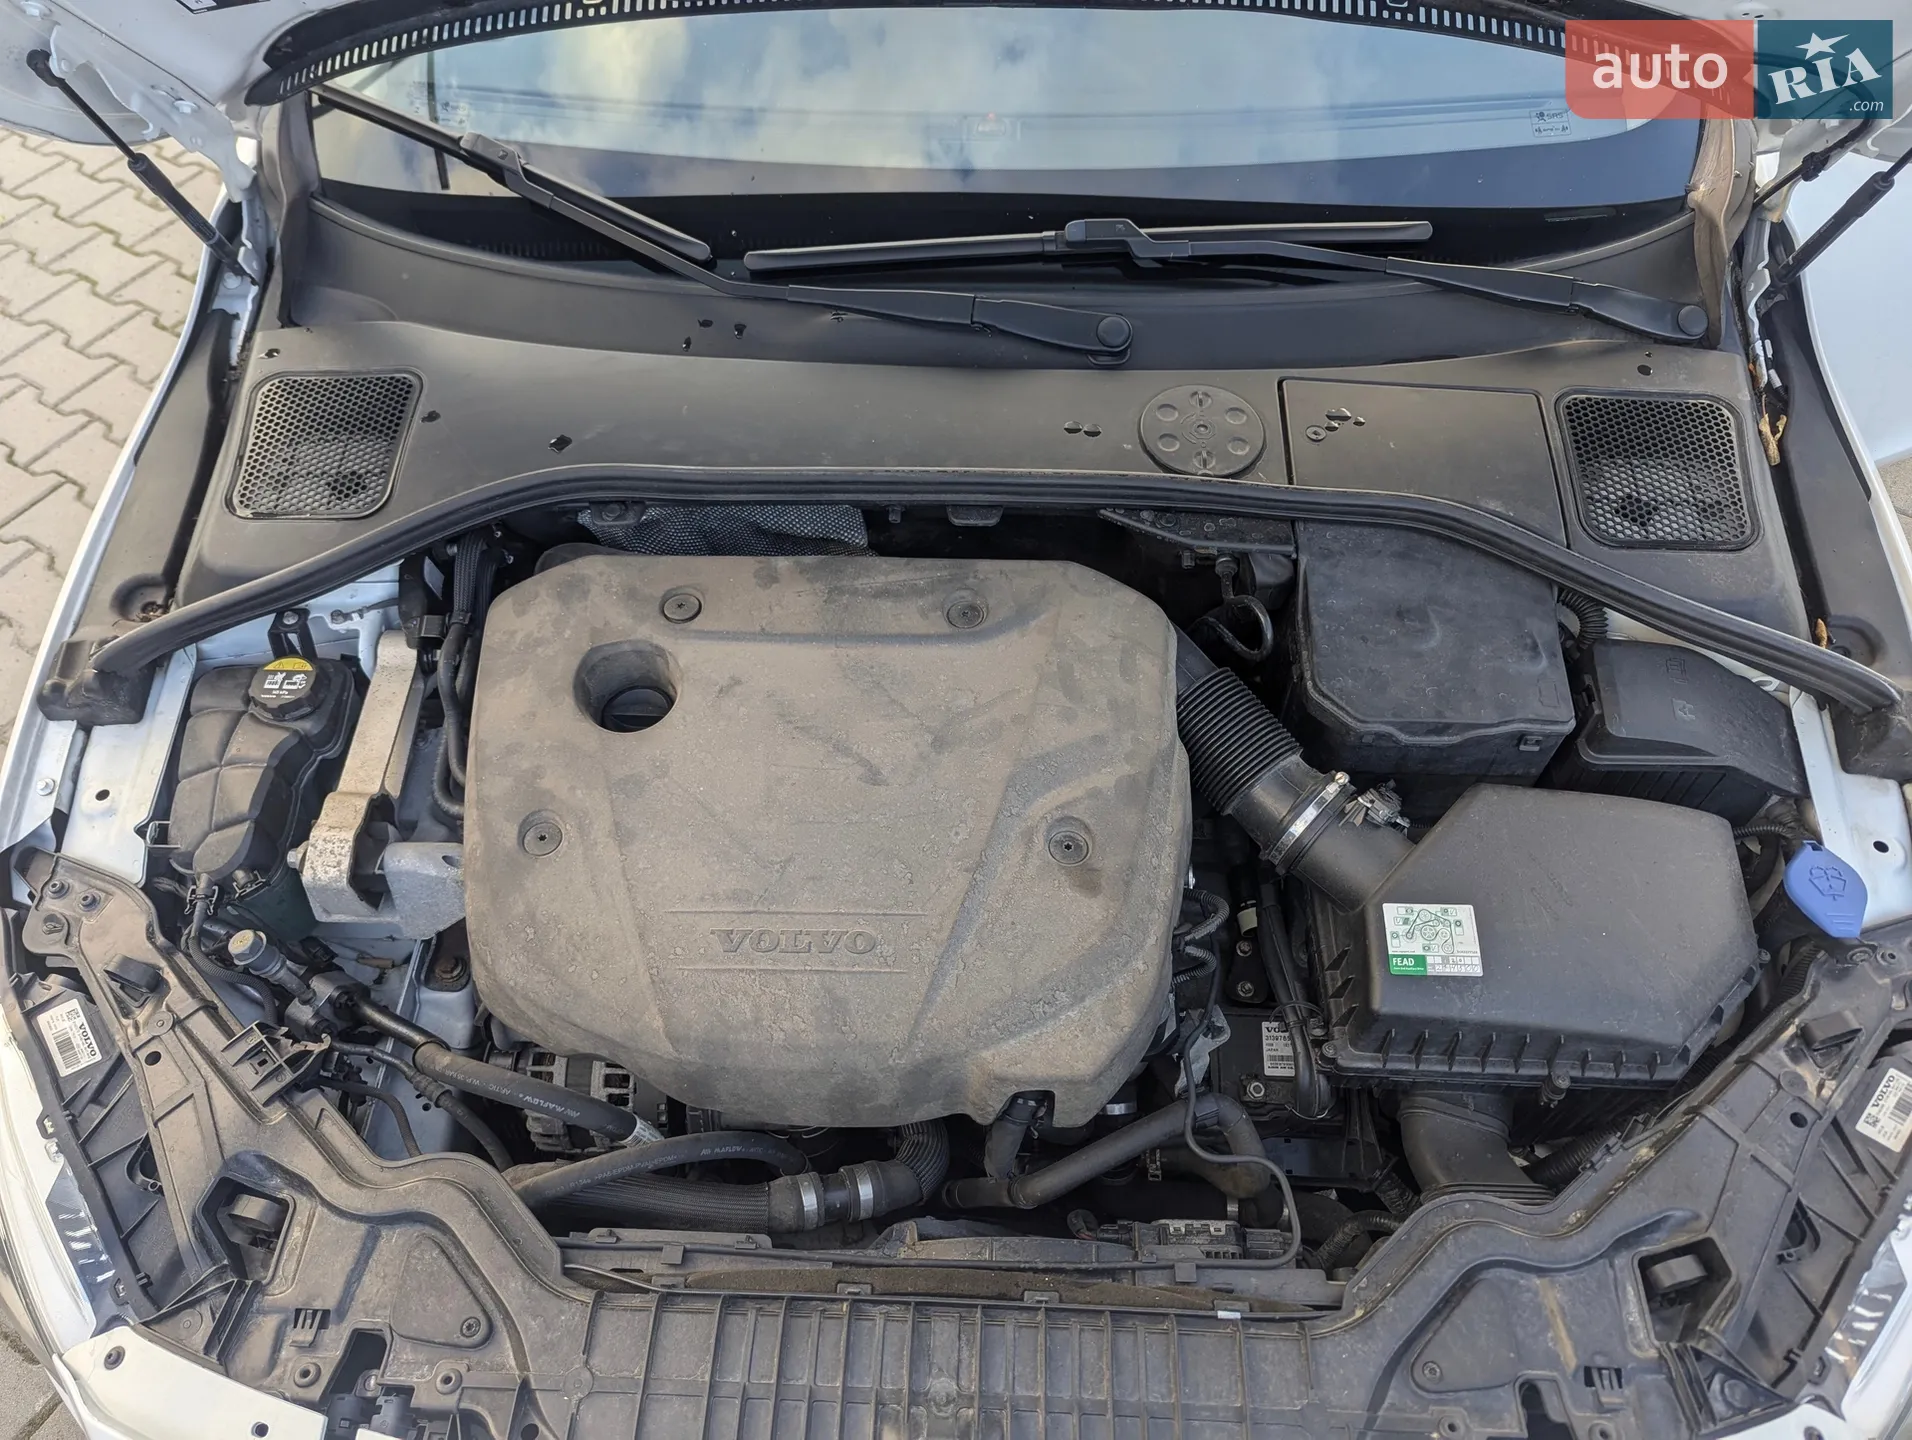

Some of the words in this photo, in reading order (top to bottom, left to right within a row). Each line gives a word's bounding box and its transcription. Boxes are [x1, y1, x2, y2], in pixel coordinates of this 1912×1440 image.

[710, 928, 877, 954] VOLVO
[1393, 957, 1415, 966] FEAD
[79, 1022, 97, 1056] VOLVO
[1872, 1075, 1895, 1108] VOLVO
